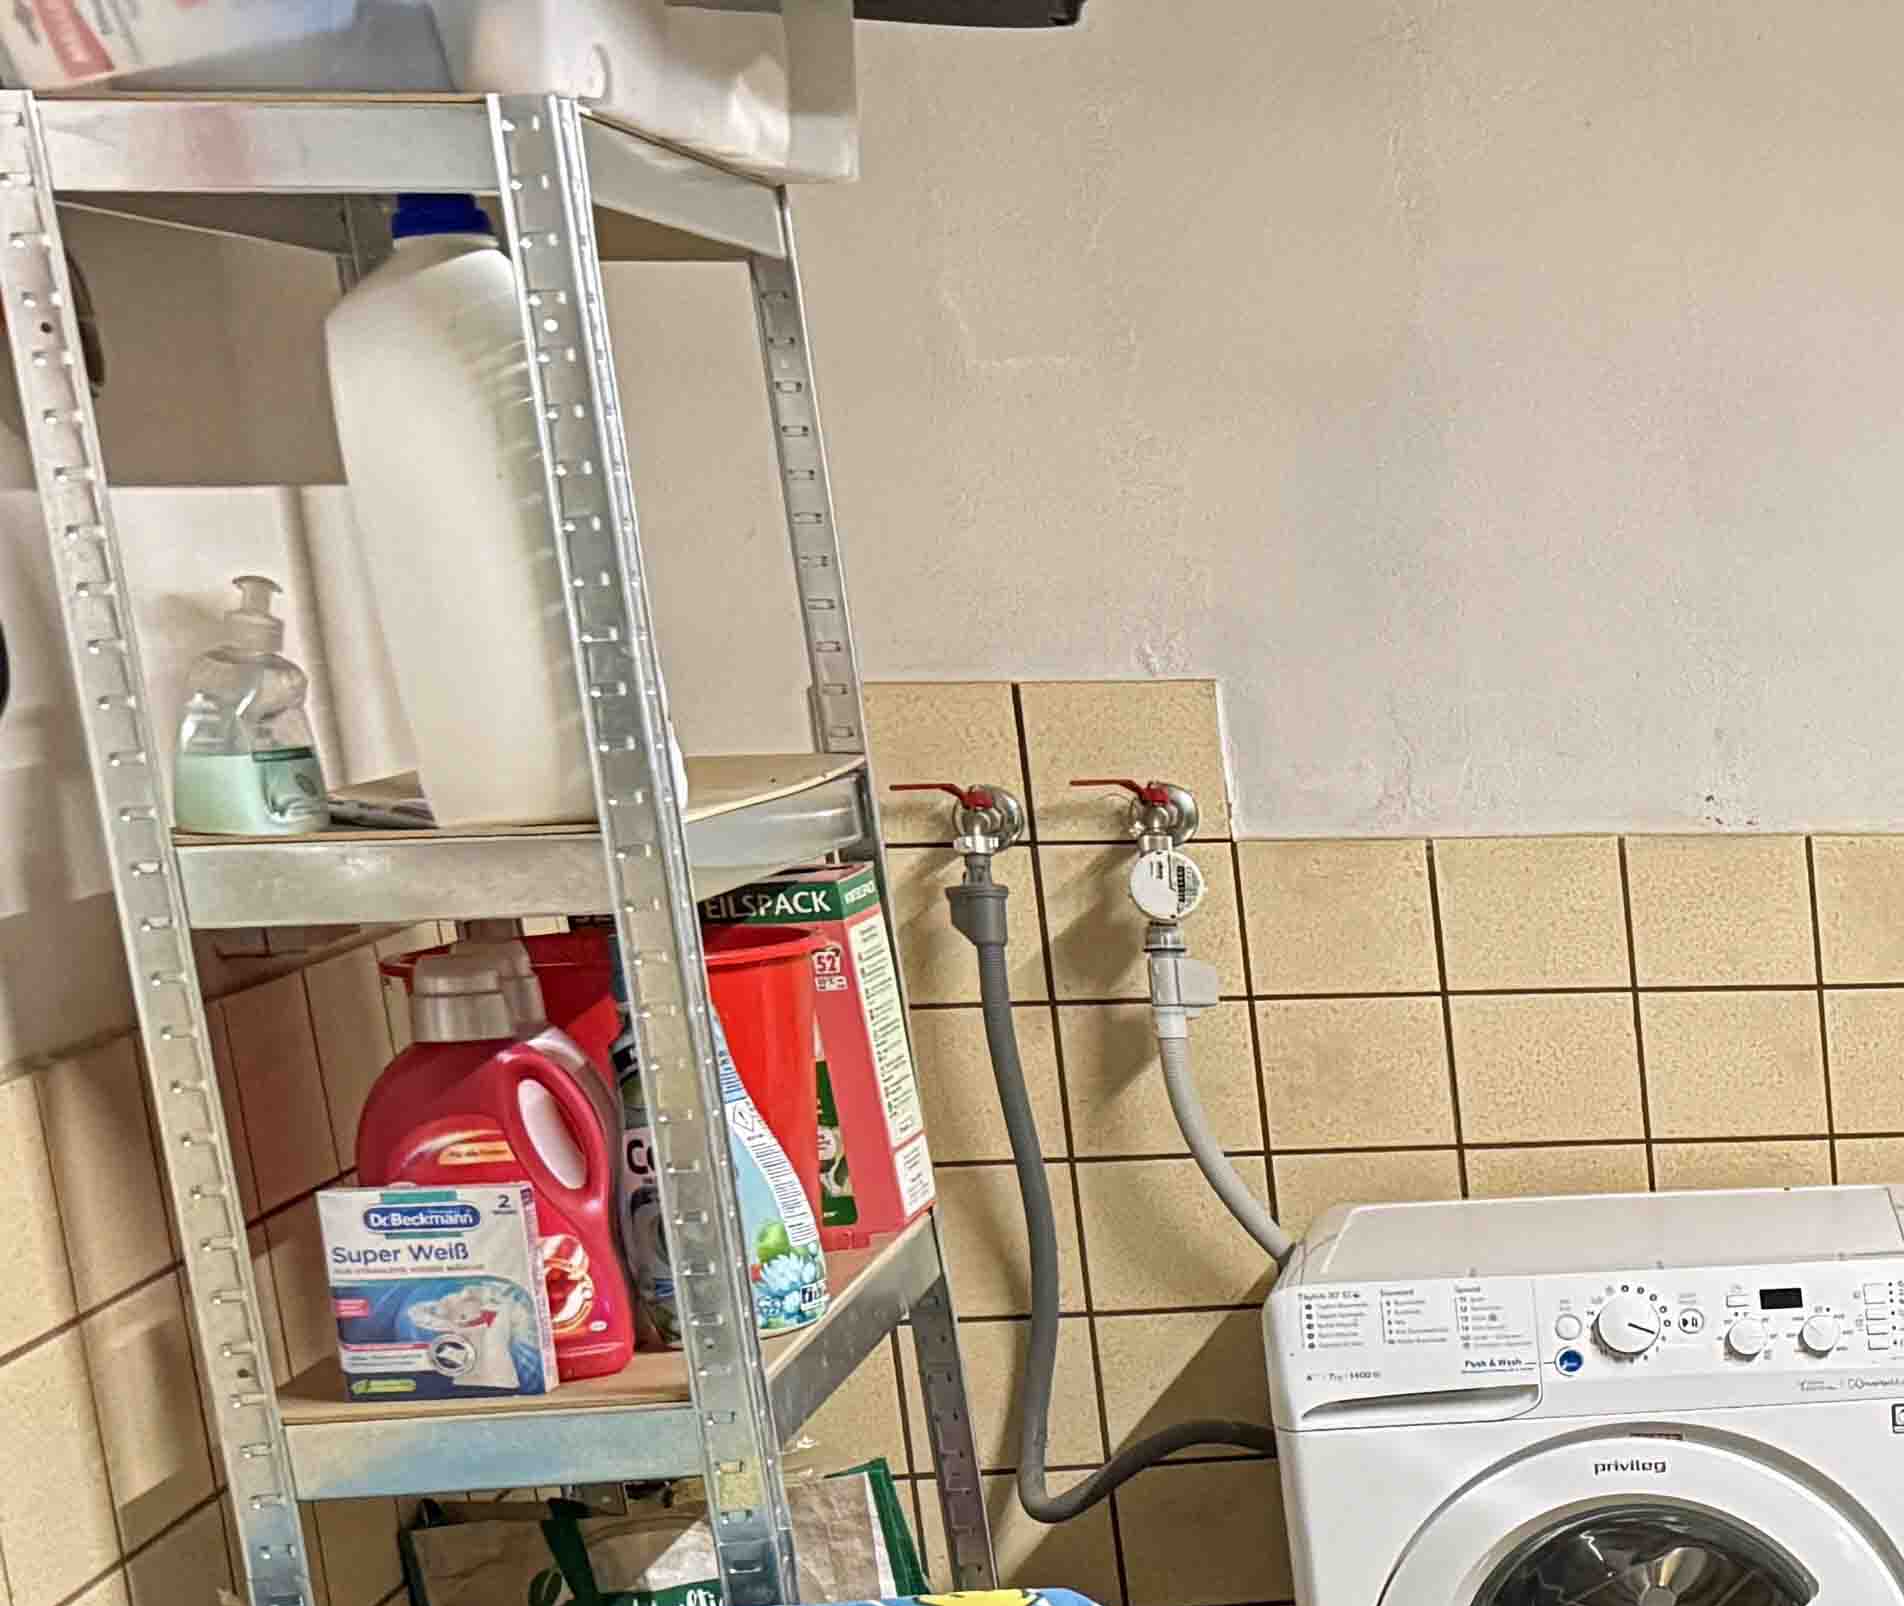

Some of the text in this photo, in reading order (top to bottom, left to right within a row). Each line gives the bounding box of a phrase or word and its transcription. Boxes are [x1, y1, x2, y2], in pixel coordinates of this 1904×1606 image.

[704, 889, 832, 920] EILSPACK
[816, 951, 838, 974] 52
[497, 1194, 511, 1209] 2
[332, 1242, 469, 1265] Super Weiß
[1593, 1459, 1667, 1476] privileg
